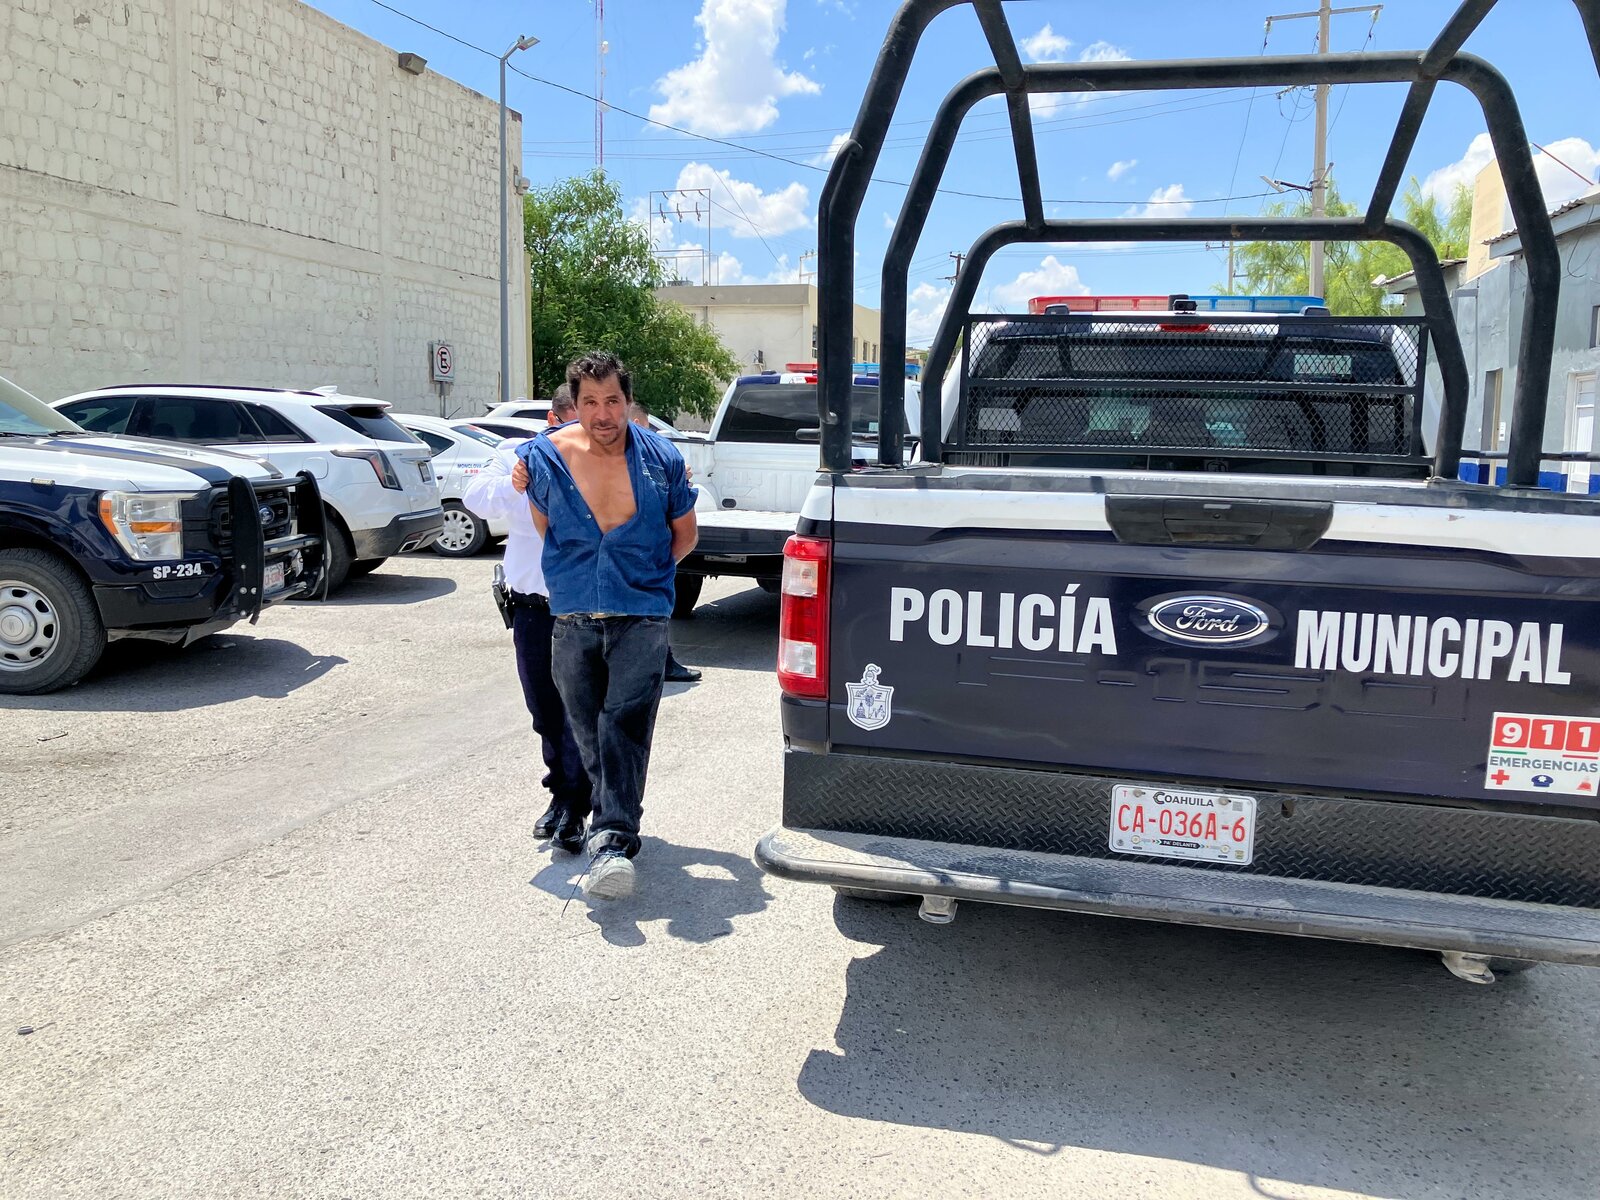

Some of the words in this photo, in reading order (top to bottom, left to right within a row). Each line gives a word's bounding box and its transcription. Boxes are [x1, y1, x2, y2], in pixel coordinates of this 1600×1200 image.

[152, 562, 202, 579] SP-234
[1174, 604, 1242, 634] Ford
[889, 583, 1118, 655] POLICÍA
[1294, 609, 1572, 685] MUNICIPAL
[1489, 755, 1599, 773] EMERGENCIAS
[1152, 791, 1214, 807] COAHUILA
[1117, 804, 1246, 843] CA-036A-6
